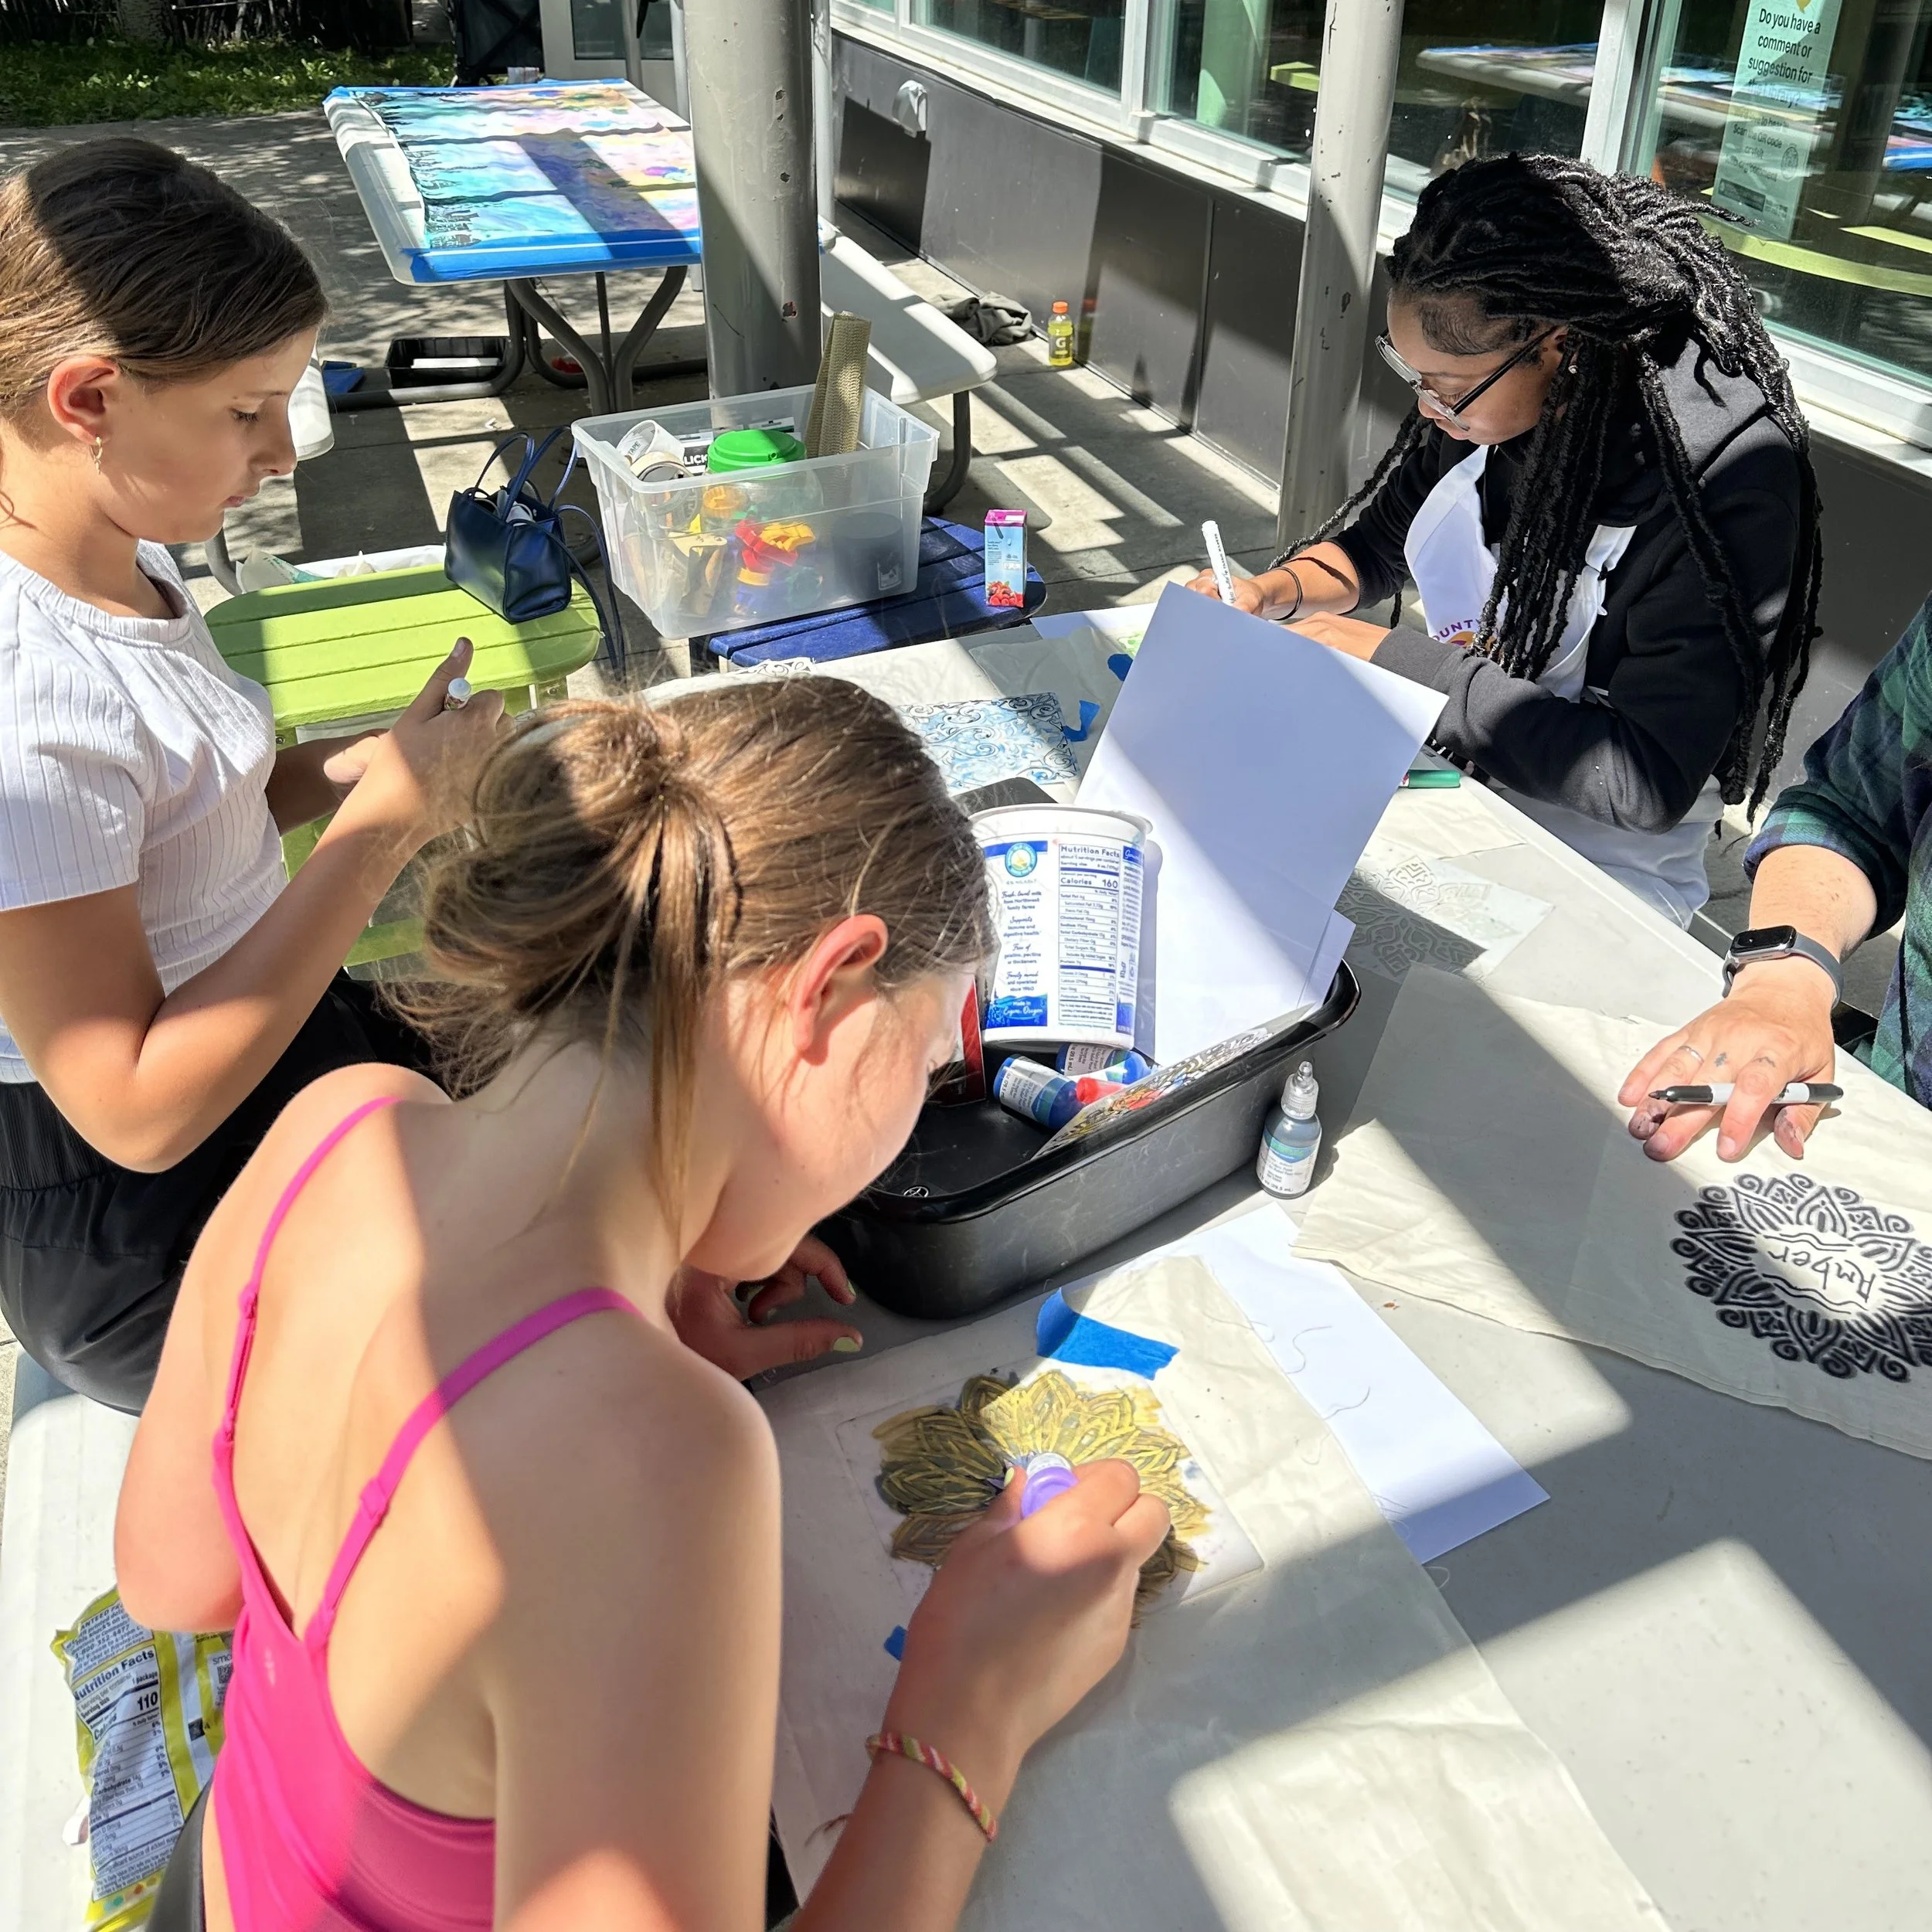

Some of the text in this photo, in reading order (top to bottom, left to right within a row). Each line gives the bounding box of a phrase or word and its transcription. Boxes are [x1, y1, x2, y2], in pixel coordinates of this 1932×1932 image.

[1759, 9, 1821, 34] Do you have a
[1758, 34, 1812, 58] comment or
[1748, 57, 1813, 84] suggestion for
[1733, 124, 1747, 136] Scan
[1767, 135, 1782, 148] code
[1056, 337, 1066, 348] G
[1434, 619, 1481, 641] OUNT
[1102, 849, 1119, 858] Facts
[1102, 879, 1117, 888] 160
[73, 1667, 120, 1701] Nutrition
[121, 1650, 155, 1670] Facts
[135, 1670, 158, 1684] package
[137, 1692, 158, 1711] 110
[94, 1777, 131, 1796] Carbohydrate
